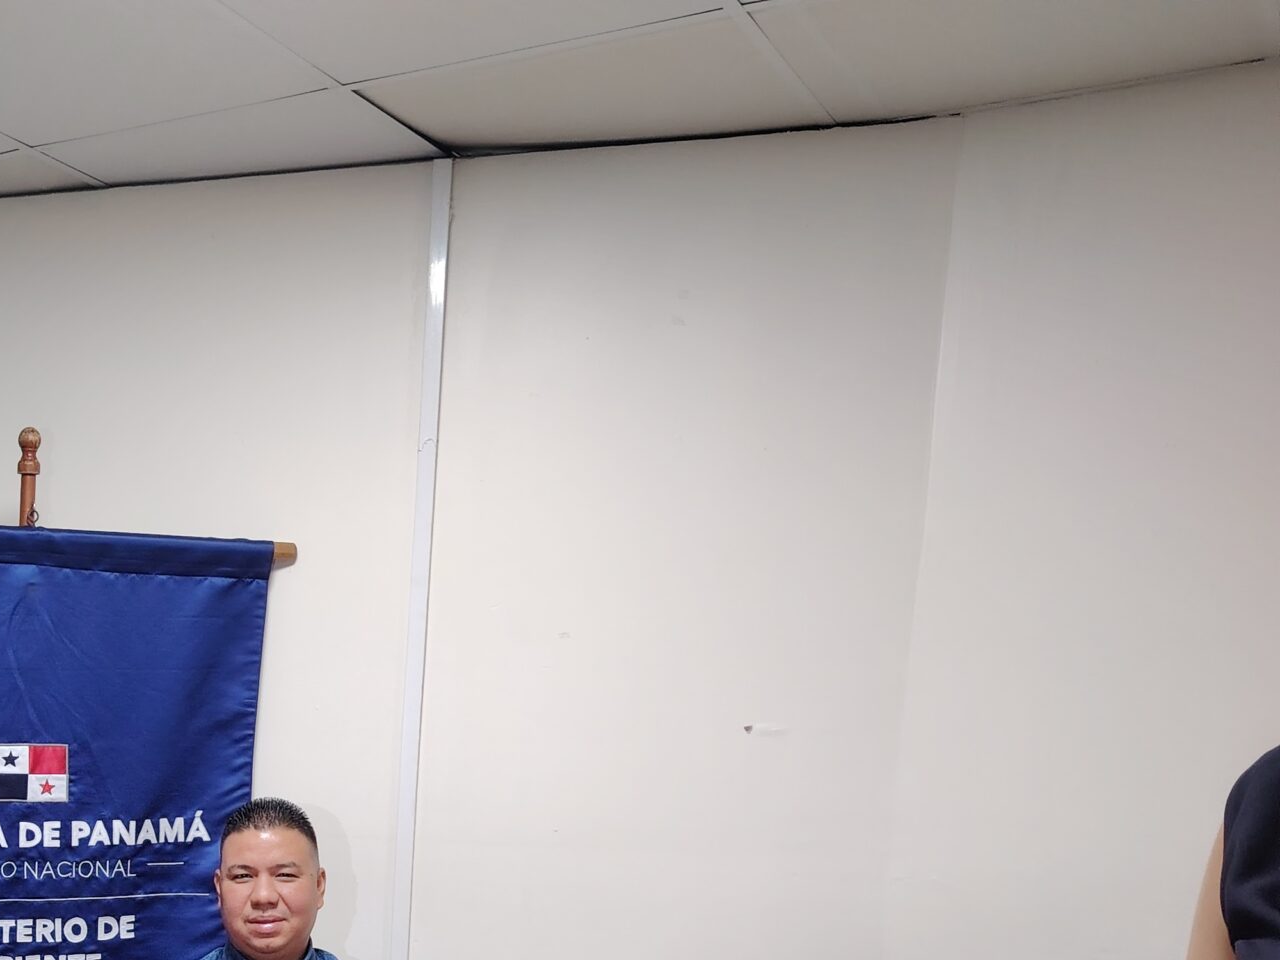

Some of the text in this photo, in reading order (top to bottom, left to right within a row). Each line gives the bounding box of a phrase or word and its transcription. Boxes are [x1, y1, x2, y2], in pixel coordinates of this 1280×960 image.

[18, 820, 62, 848] DE
[71, 810, 211, 847] PANAMÁ
[23, 860, 137, 880] NACIONAL
[97, 914, 136, 941] DE
